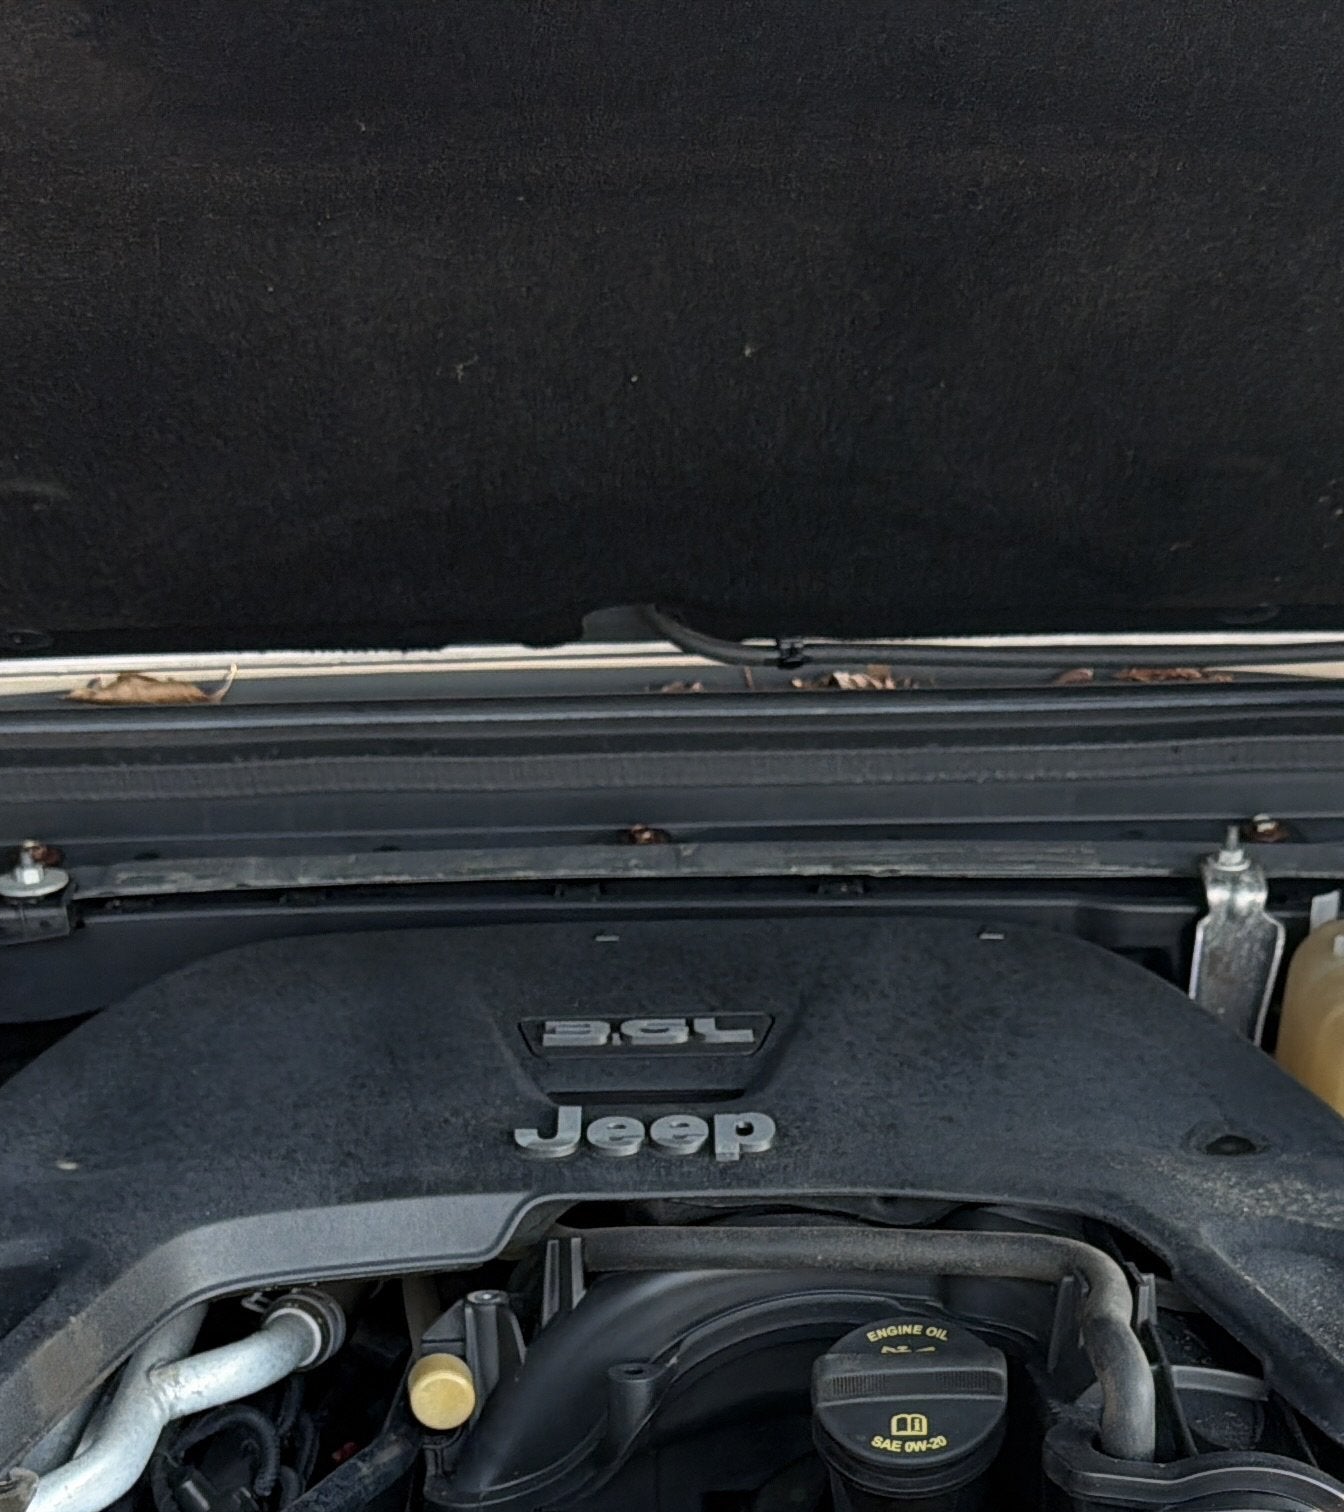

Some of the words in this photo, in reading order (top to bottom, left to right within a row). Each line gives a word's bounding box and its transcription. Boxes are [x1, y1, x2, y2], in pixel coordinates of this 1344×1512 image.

[542, 1018, 755, 1047] 3.6L
[514, 1105, 776, 1161] Jeep
[866, 1324, 923, 1343] ENGINE
[926, 1325, 950, 1342] OIL
[871, 1435, 902, 1453] SAE
[905, 1435, 948, 1453] 0W-20
